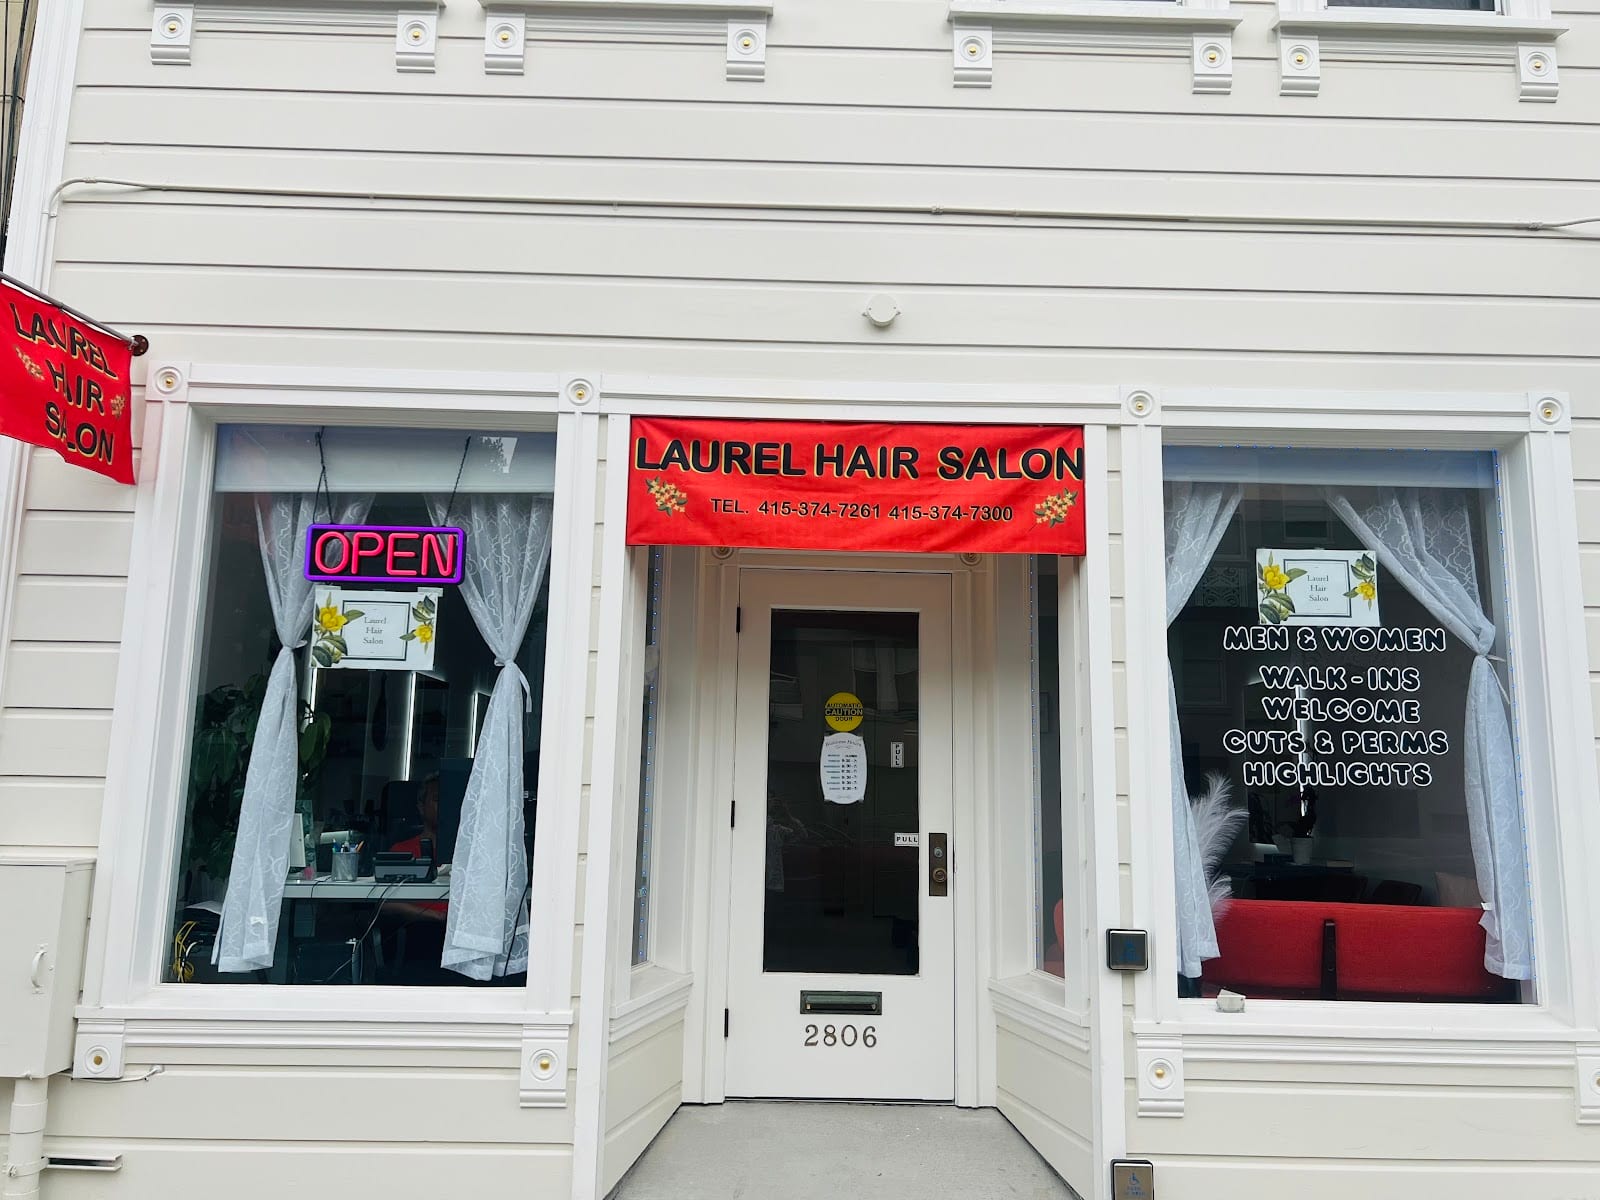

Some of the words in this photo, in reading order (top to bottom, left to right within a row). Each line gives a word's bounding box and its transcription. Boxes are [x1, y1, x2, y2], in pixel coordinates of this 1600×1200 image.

[9, 302, 119, 380] LAUREL
[635, 437, 806, 476] LAUREL
[814, 443, 919, 479] HAIR
[937, 446, 1083, 481] SALON
[710, 498, 749, 514] TEL.
[758, 500, 880, 518] 415-374-7261
[888, 505, 1013, 521] 415-374-7300
[314, 531, 455, 577] OPEN
[1306, 574, 1329, 582] Laurel
[1310, 584, 1327, 592] Hair
[1308, 594, 1329, 602] Salon
[364, 616, 387, 625] Laurel
[362, 637, 384, 645] Salon
[1223, 625, 1289, 651] MEN
[1296, 627, 1317, 651] &
[1320, 627, 1447, 652] WOMEN
[1261, 696, 1420, 724] WELCOME
[1223, 729, 1307, 755] CUTS
[1313, 730, 1335, 755] &
[1341, 730, 1449, 755] PERMS
[1242, 761, 1433, 786] HIGHLIGHTS
[804, 1024, 877, 1048] 2806
